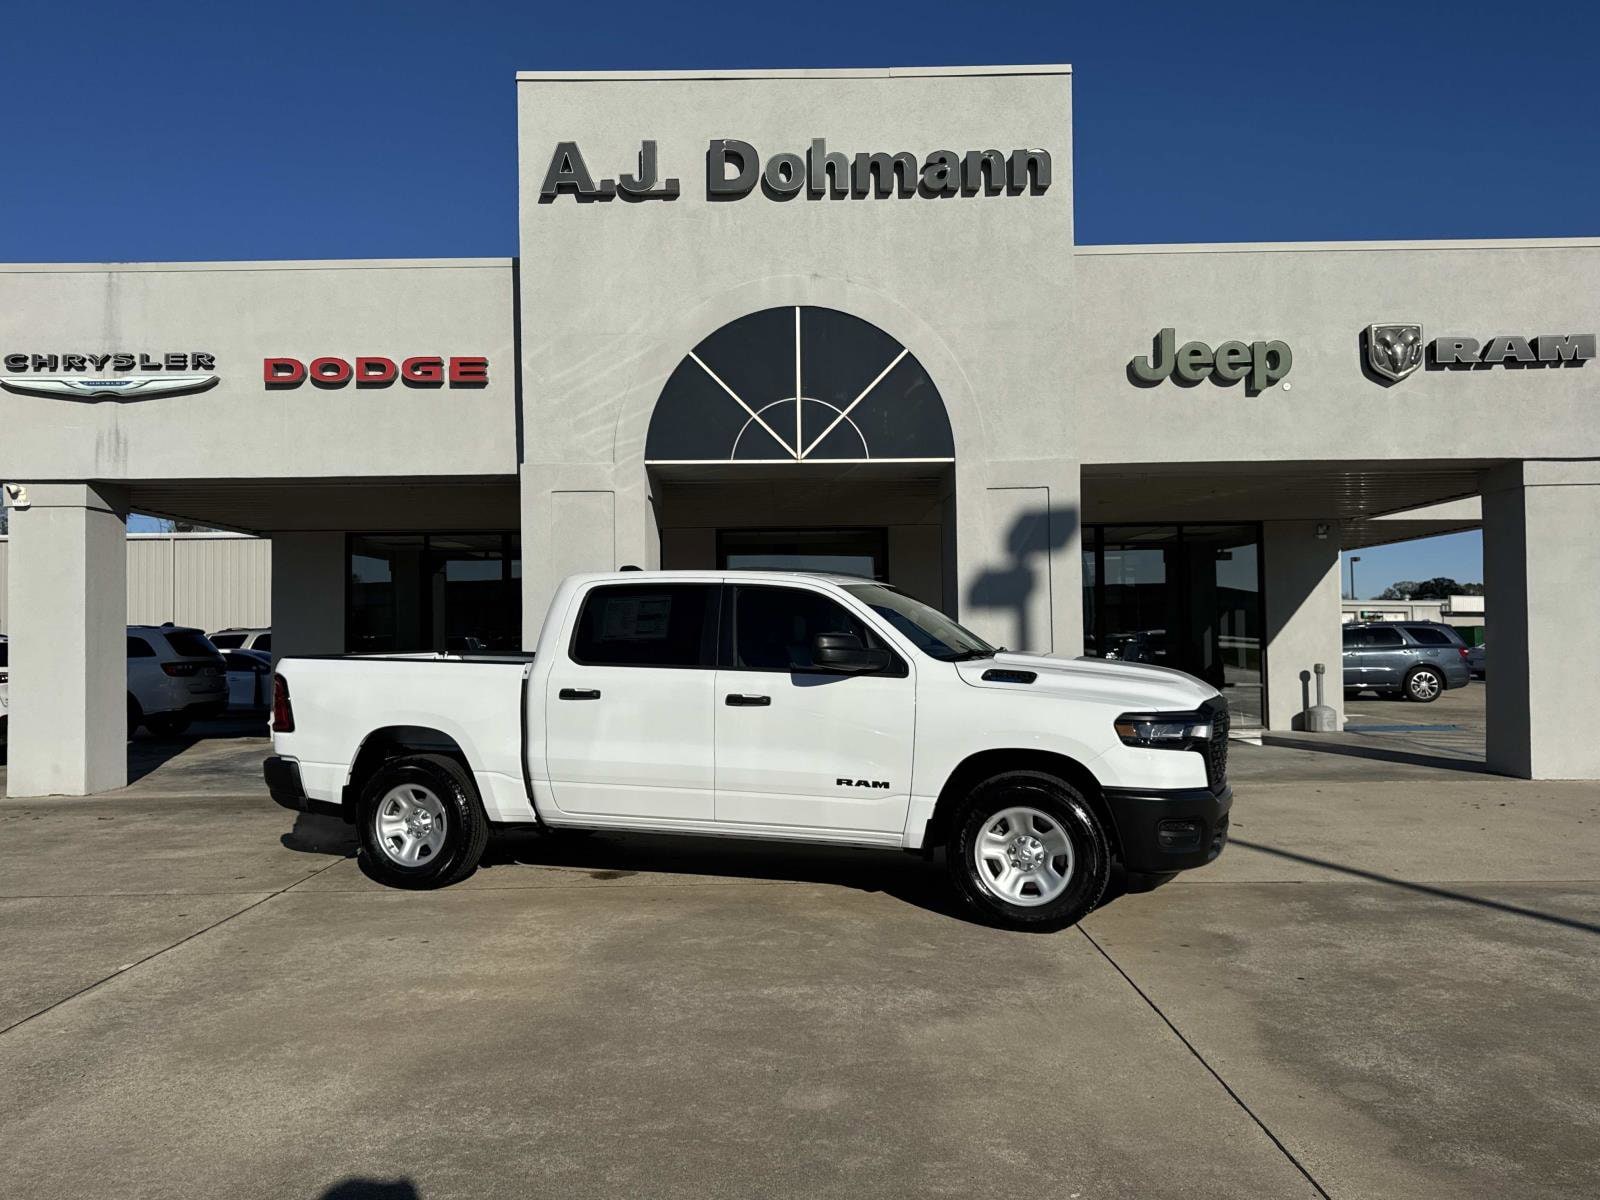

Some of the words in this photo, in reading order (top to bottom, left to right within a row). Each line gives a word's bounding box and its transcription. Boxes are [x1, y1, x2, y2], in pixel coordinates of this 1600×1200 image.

[539, 139, 681, 202] A.J.
[707, 138, 1053, 200] Dohmann
[3, 352, 216, 372] CHRYSLER
[1127, 327, 1293, 397] Jeep
[1428, 333, 1597, 370] RAM
[264, 356, 489, 389] DODGE
[836, 778, 890, 789] RAM
